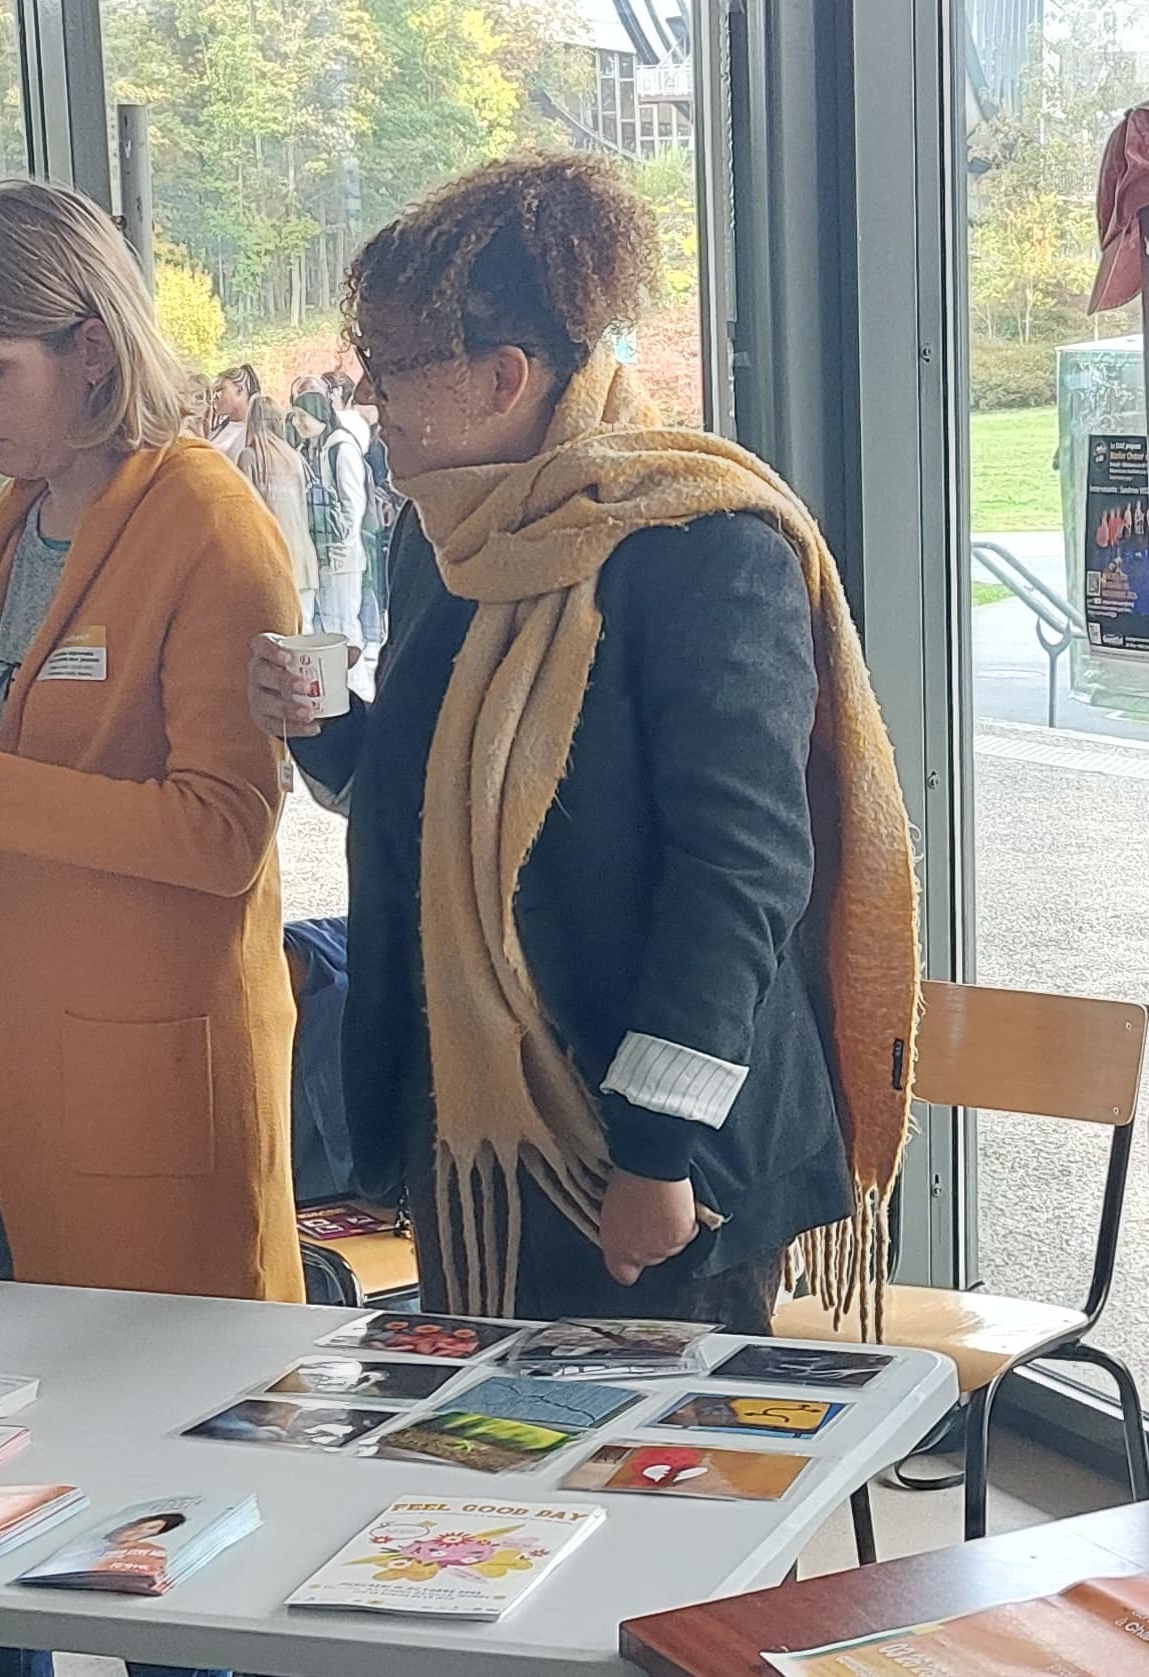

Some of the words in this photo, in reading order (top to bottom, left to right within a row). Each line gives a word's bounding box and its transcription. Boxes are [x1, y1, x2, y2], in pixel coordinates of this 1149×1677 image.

[391, 1503, 451, 1512] FEEL
[462, 1504, 529, 1516] GOOD
[535, 1509, 588, 1521] DAY
